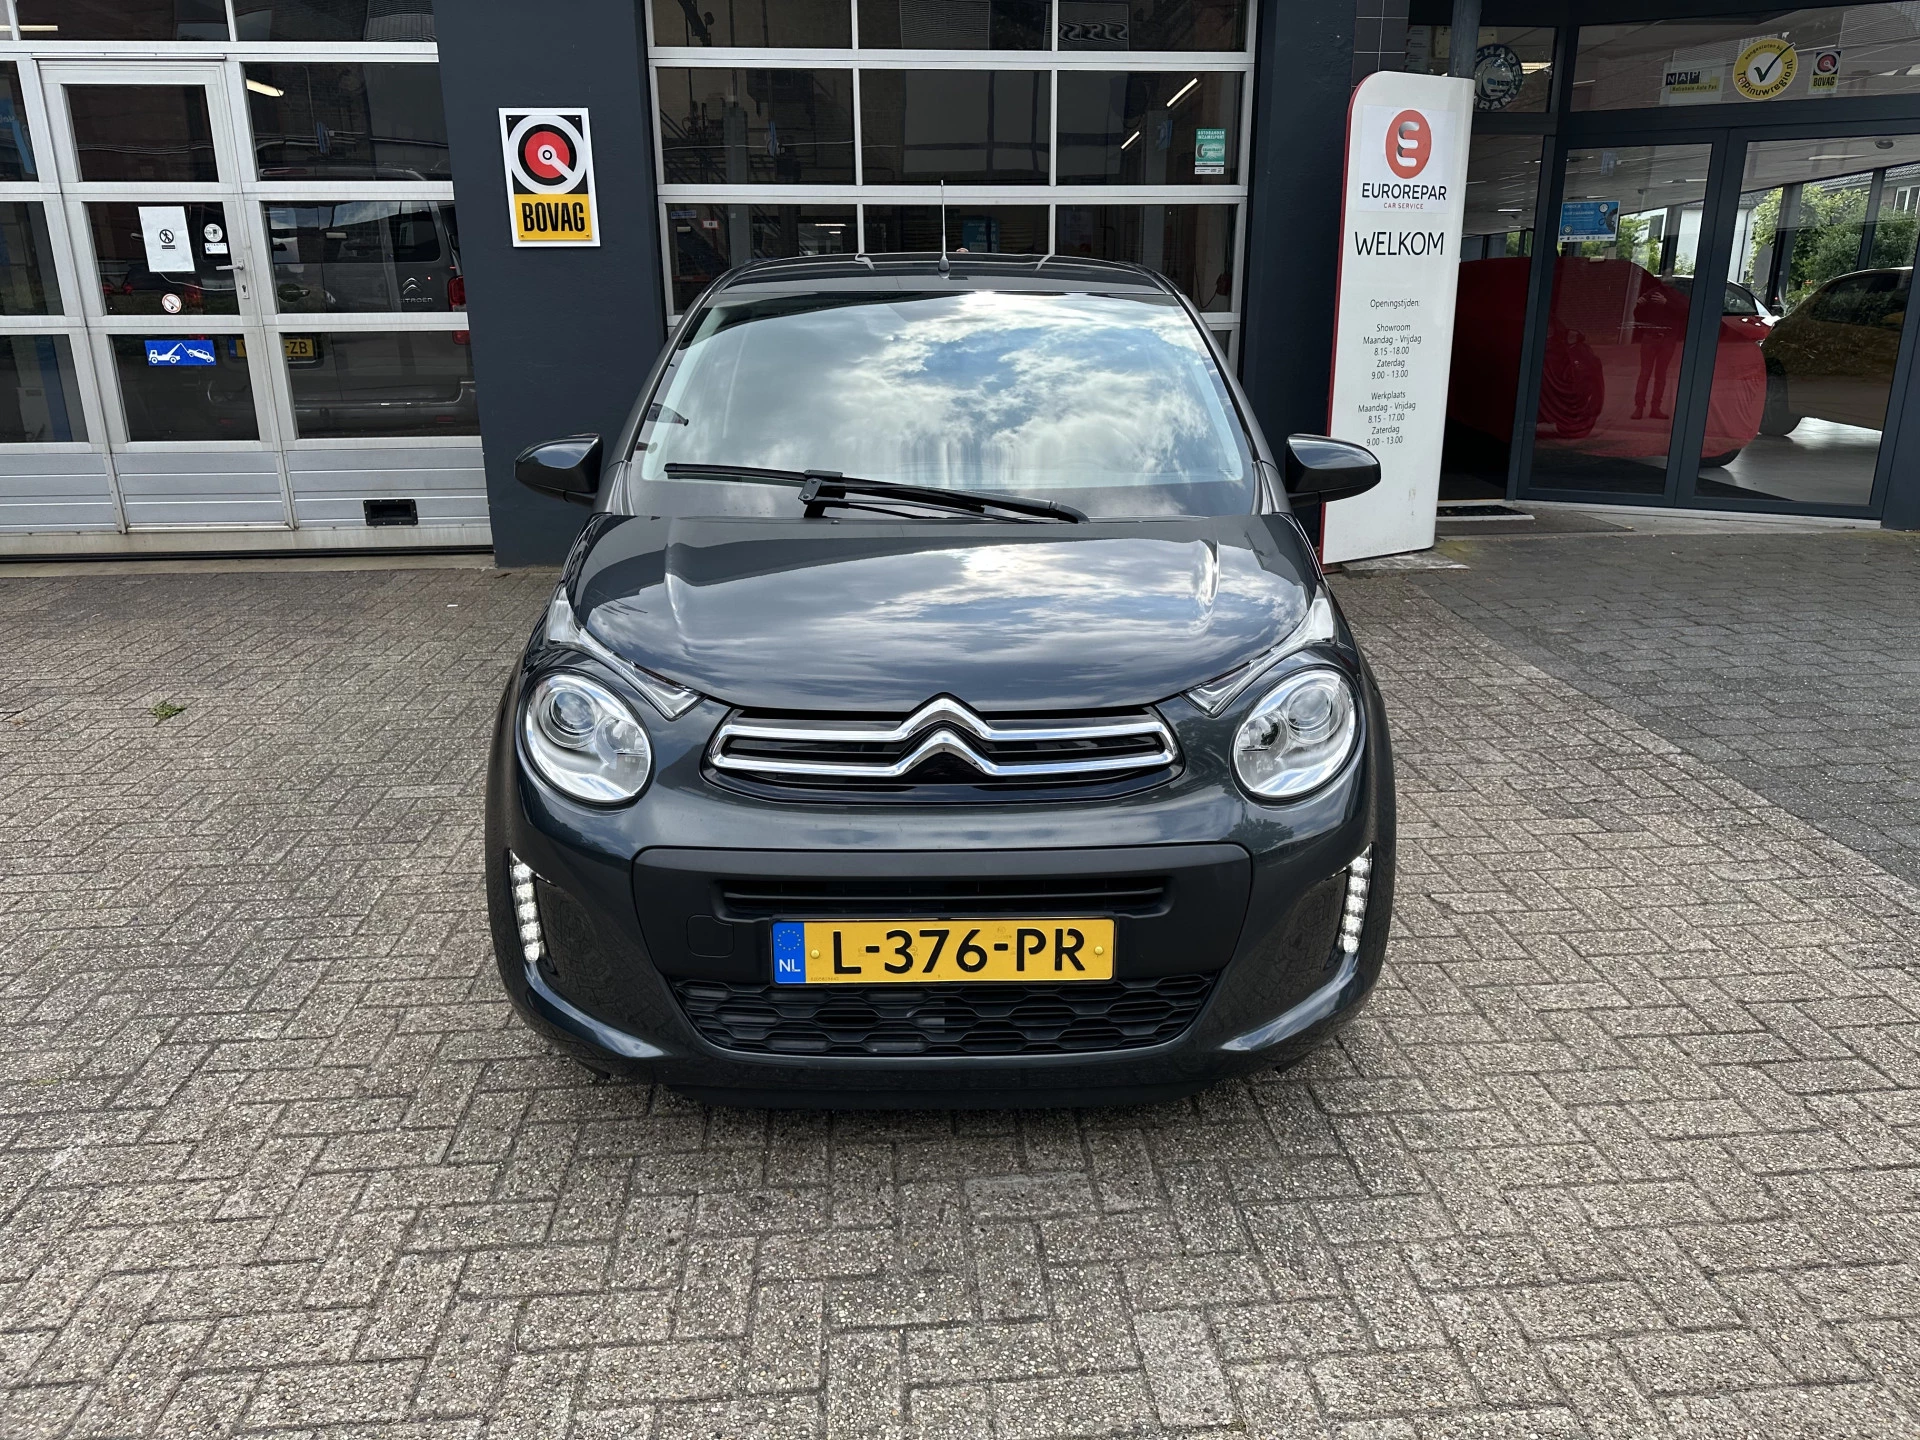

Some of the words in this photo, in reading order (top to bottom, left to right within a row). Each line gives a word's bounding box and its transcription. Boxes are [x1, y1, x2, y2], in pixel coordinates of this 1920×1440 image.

[1475, 46, 1521, 75] CHADE
[1667, 70, 1699, 84] NAP
[1813, 76, 1835, 87] BOVAG
[1473, 88, 1517, 110] ARANT
[1361, 182, 1447, 201] EUROREPAR
[521, 202, 586, 232] BOVAG
[1354, 231, 1445, 256] WELKOM
[1376, 323, 1411, 332] Showroom
[1363, 336, 1394, 346] Maandag
[1399, 334, 1422, 345] Vrijdag
[1374, 347, 1388, 356] 8.15
[1376, 358, 1406, 368] Zaterdag
[1371, 371, 1385, 380] 9.00
[1392, 369, 1409, 379] 13.00
[1371, 390, 1406, 401] Werkplaats
[1358, 403, 1388, 413] Maandag
[1394, 401, 1416, 411] Vrijdag
[1368, 415, 1382, 424] 8.15
[1388, 413, 1405, 422] 17.00
[1371, 425, 1400, 435] Zaterdag
[1366, 437, 1380, 447] 9.00
[1386, 435, 1404, 445] 13.00
[832, 927, 1086, 975] L-376-PR
[778, 958, 801, 974] NL
